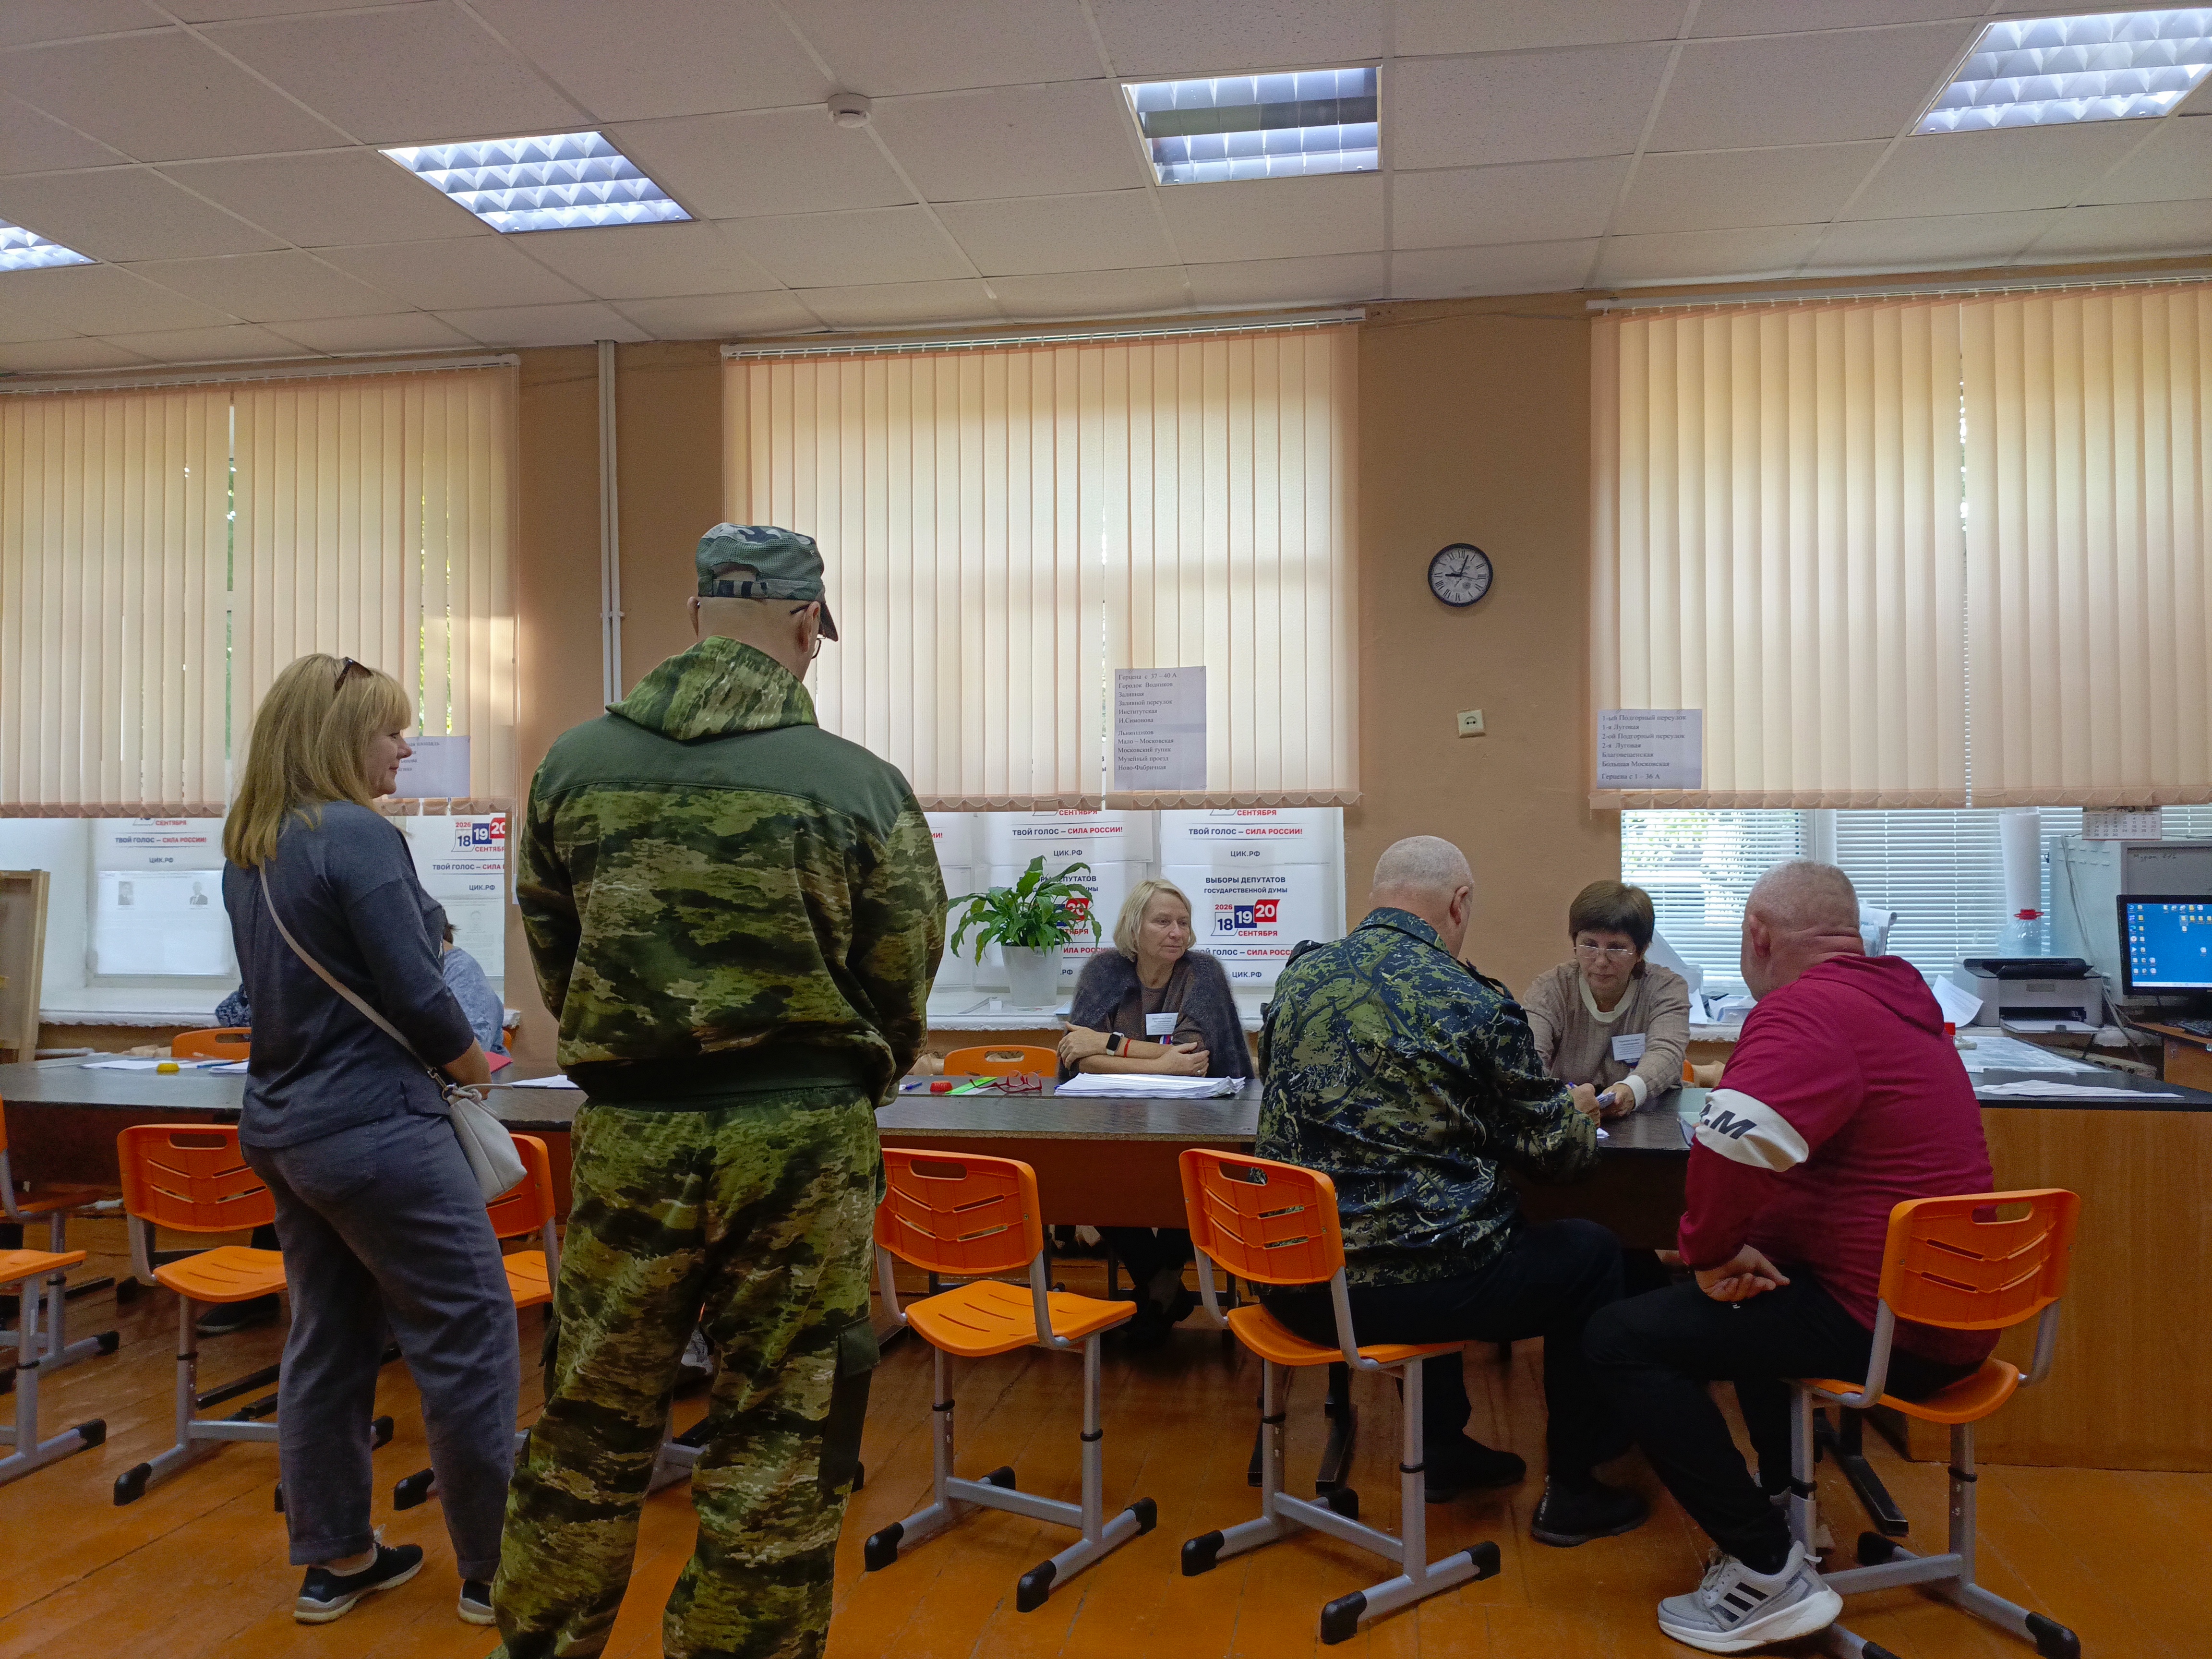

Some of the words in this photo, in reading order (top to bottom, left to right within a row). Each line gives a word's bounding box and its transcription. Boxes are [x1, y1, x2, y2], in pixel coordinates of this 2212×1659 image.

[457, 835, 471, 847] 18
[474, 828, 488, 840] 19
[491, 822, 505, 834] 20
[1217, 918, 1233, 930] 18
[1236, 911, 1252, 924] 19
[1255, 904, 1275, 917] 20
